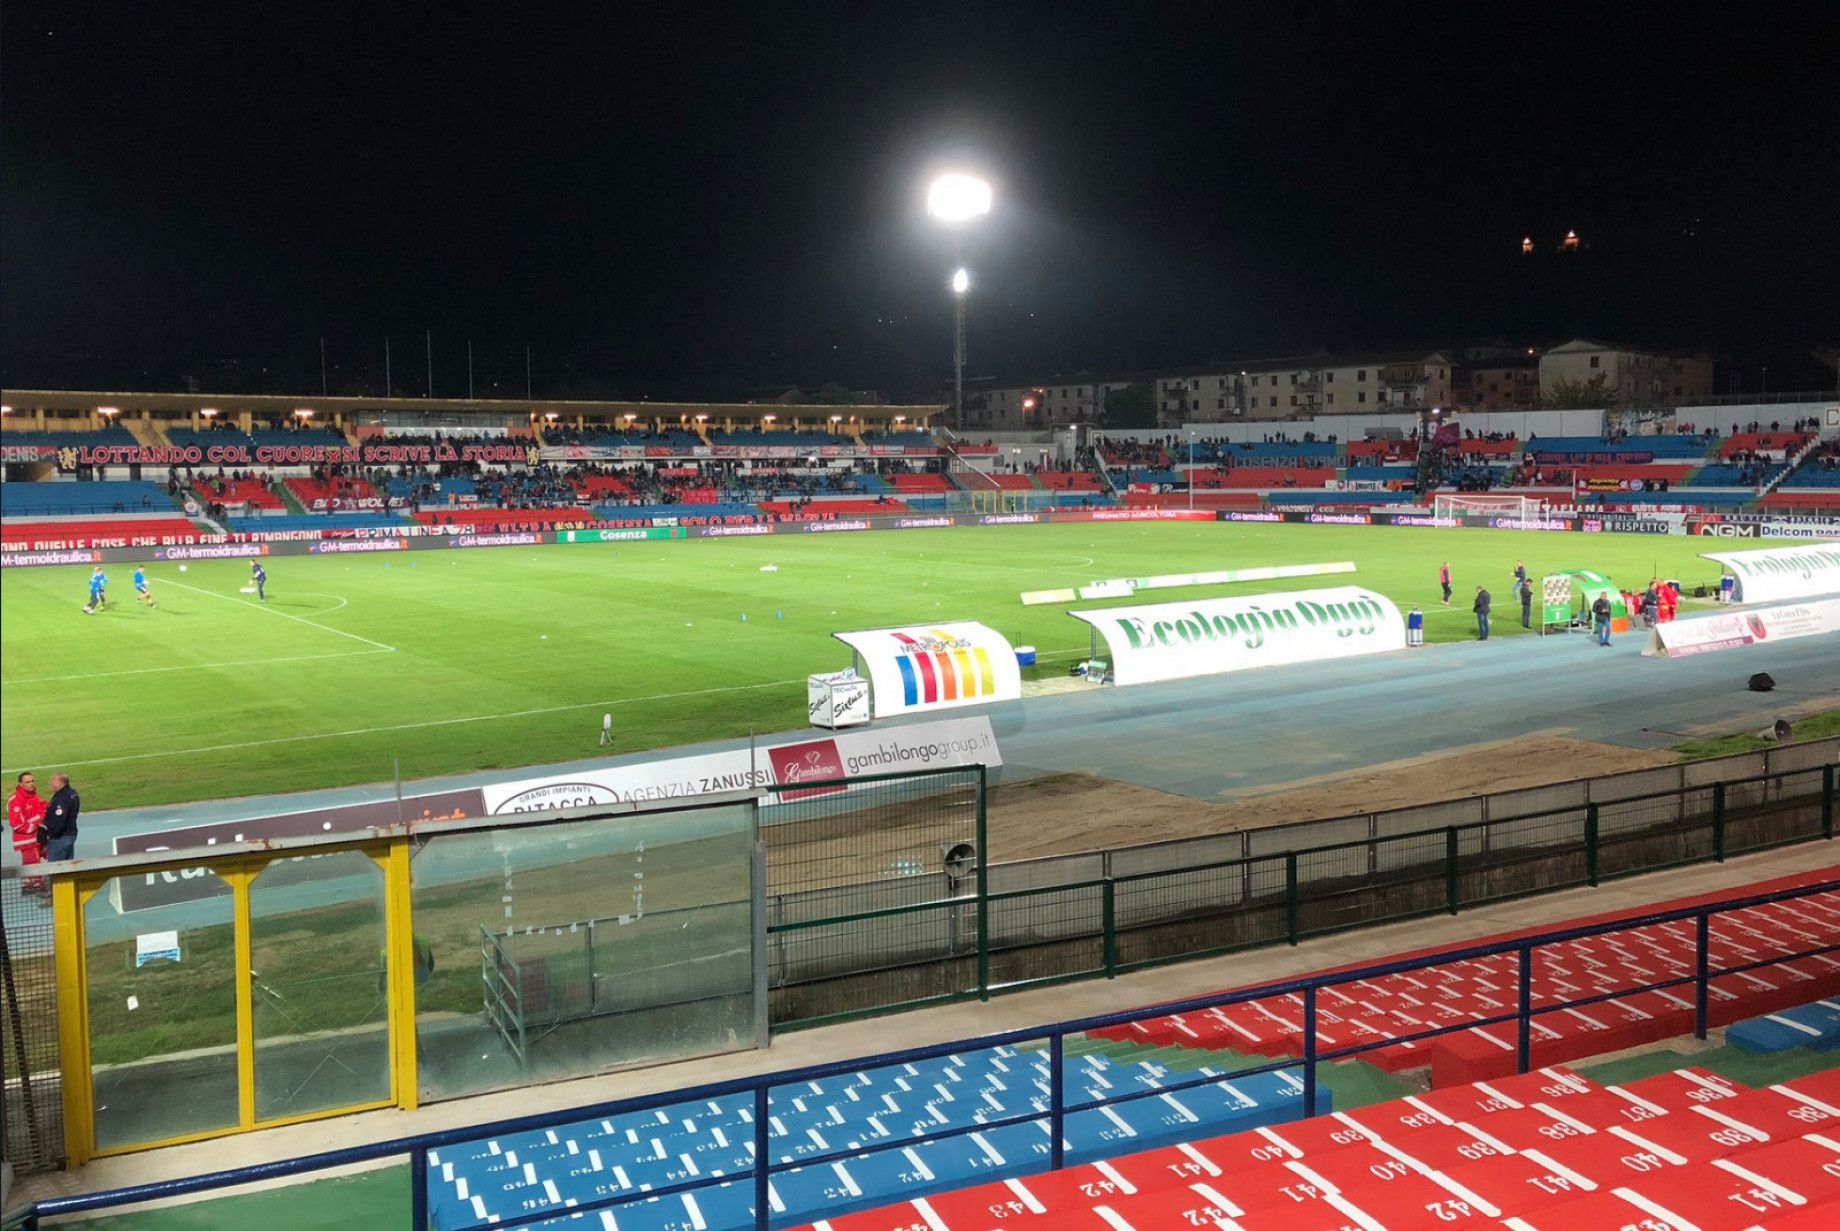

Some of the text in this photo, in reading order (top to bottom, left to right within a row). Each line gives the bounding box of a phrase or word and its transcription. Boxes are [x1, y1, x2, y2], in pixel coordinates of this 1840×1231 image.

[80, 446, 202, 464] LOTTANDO
[207, 445, 251, 463] COL
[256, 445, 325, 463] CUORE
[342, 446, 360, 462] SI
[364, 445, 430, 461] SCRIVE
[435, 445, 458, 461] LA
[463, 445, 526, 461] STORIA
[600, 529, 647, 541] Cosenza
[1615, 521, 1668, 533] RISPETTO
[1702, 524, 1754, 537] NGM
[1762, 525, 1813, 537] Delcom
[1115, 595, 1386, 649] Ecologia Oggi
[834, 690, 863, 719] Sixtus
[847, 733, 992, 775] gambilongogroup.it
[519, 786, 591, 803] GRANDI IMPIANTI
[623, 769, 770, 803] AGENZIA ZANUSSI
[1476, 1099, 1508, 1113] 37
[1620, 1105, 1655, 1122] 37
[1251, 1144, 1285, 1161] 40
[1621, 1152, 1661, 1172] 40
[1167, 1161, 1202, 1178] 41
[1369, 1161, 1408, 1180] 40
[1079, 1179, 1116, 1198] 42
[1278, 1184, 1318, 1203] 41
[1526, 1174, 1571, 1194] 41
[988, 1200, 1024, 1219] 43
[1727, 1188, 1782, 1213] 41
[1182, 1206, 1223, 1226] 42
[1425, 1200, 1472, 1222] 42
